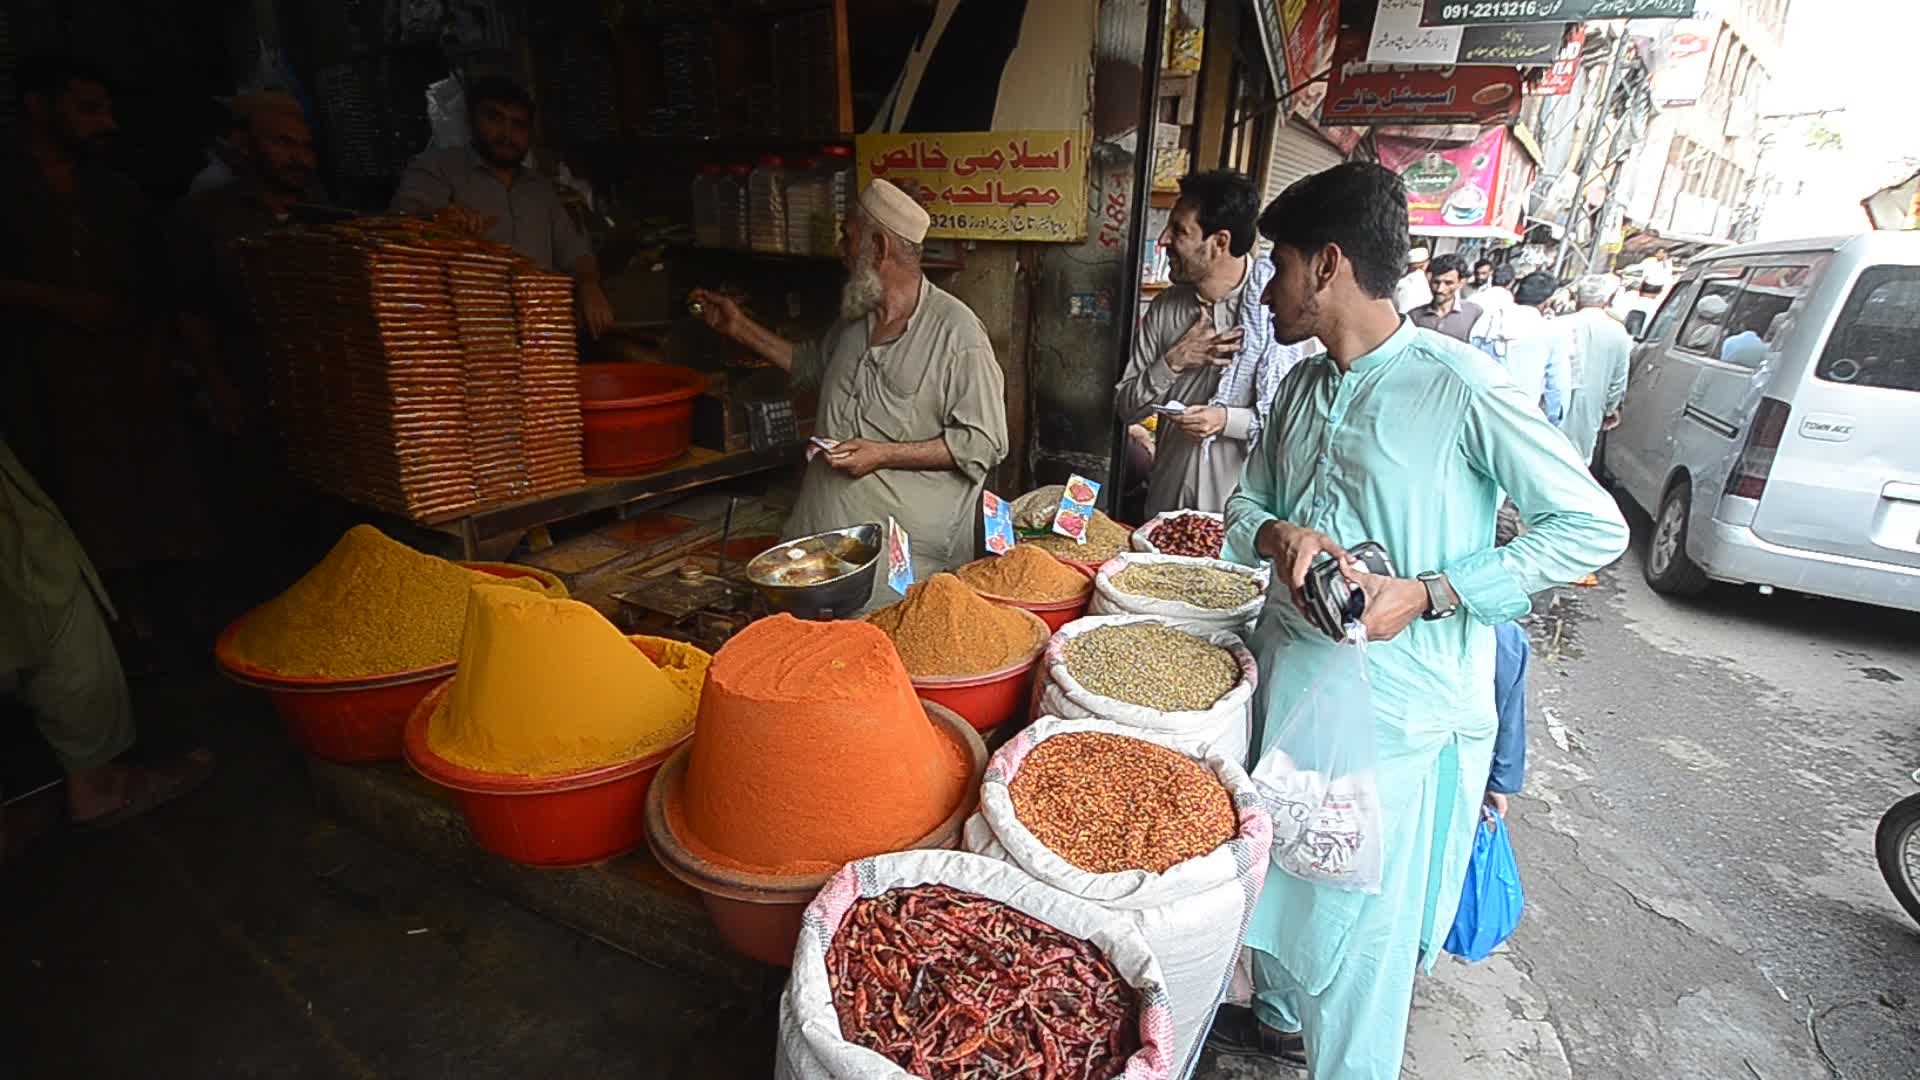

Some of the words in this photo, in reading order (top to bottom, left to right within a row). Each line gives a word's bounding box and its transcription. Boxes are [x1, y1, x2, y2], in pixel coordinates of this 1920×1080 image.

[1443, 2, 1536, 19] 091-2213216
[869, 140, 949, 178] خالص
[954, 138, 1072, 177] اسلامی
[930, 213, 967, 229] 3216
